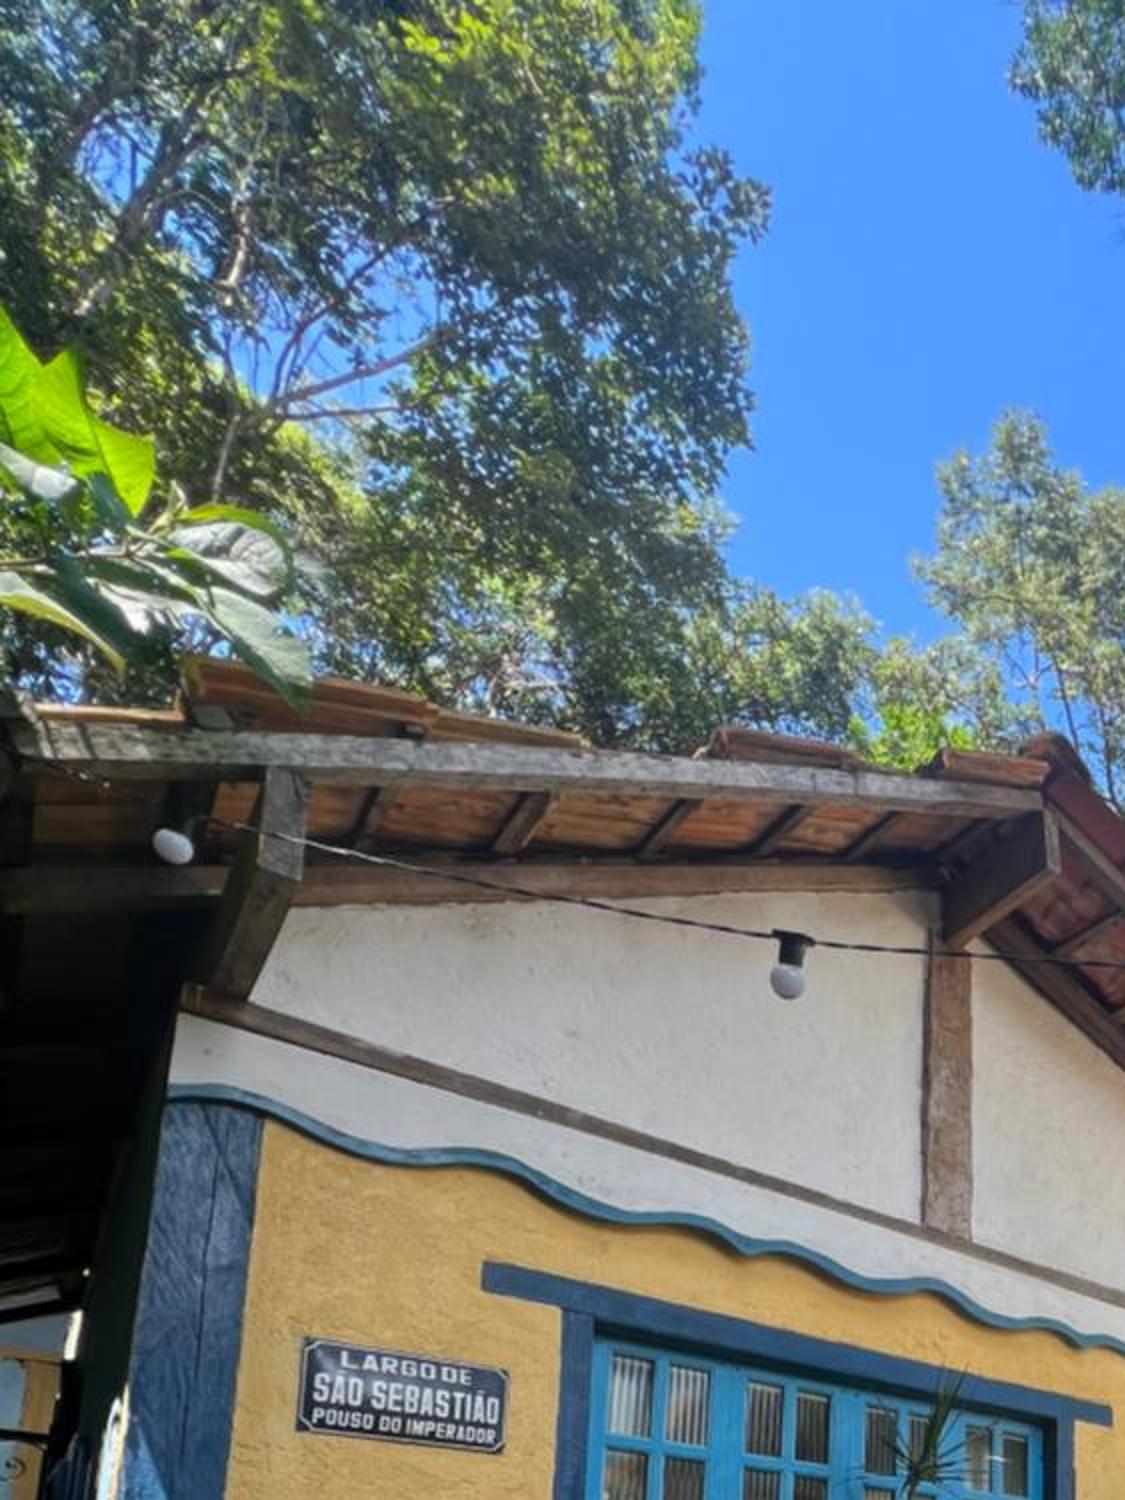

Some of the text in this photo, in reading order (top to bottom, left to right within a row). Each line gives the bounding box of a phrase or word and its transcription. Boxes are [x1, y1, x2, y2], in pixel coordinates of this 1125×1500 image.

[341, 1351, 473, 1386] LARGO DE
[313, 1369, 499, 1425] SÃO SEBASTIÃO
[312, 1407, 497, 1444] POUSO DO IMPERADOR
